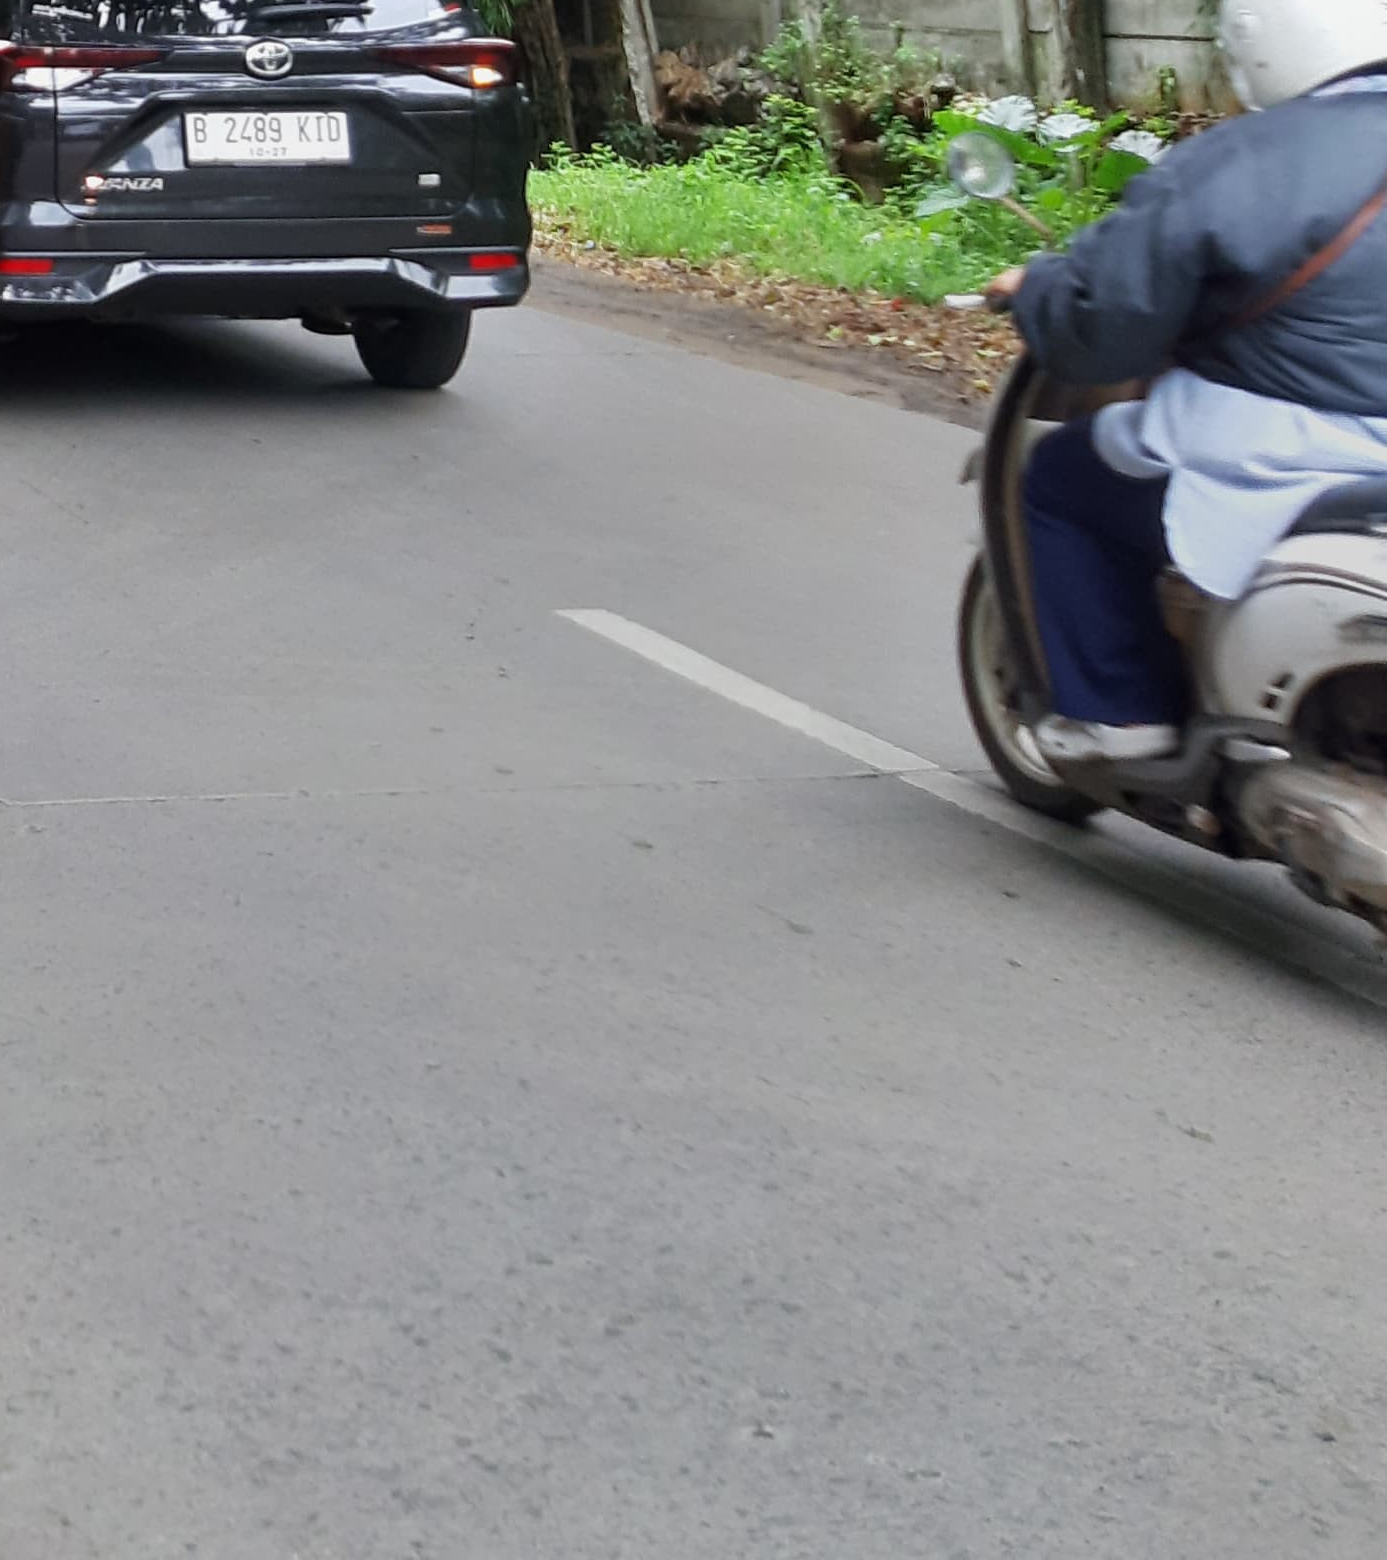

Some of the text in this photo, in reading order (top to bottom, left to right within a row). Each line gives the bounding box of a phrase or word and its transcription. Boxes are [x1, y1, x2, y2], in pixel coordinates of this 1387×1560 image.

[193, 116, 207, 143] B
[224, 116, 283, 143] 2489
[81, 176, 164, 191] ANZA
